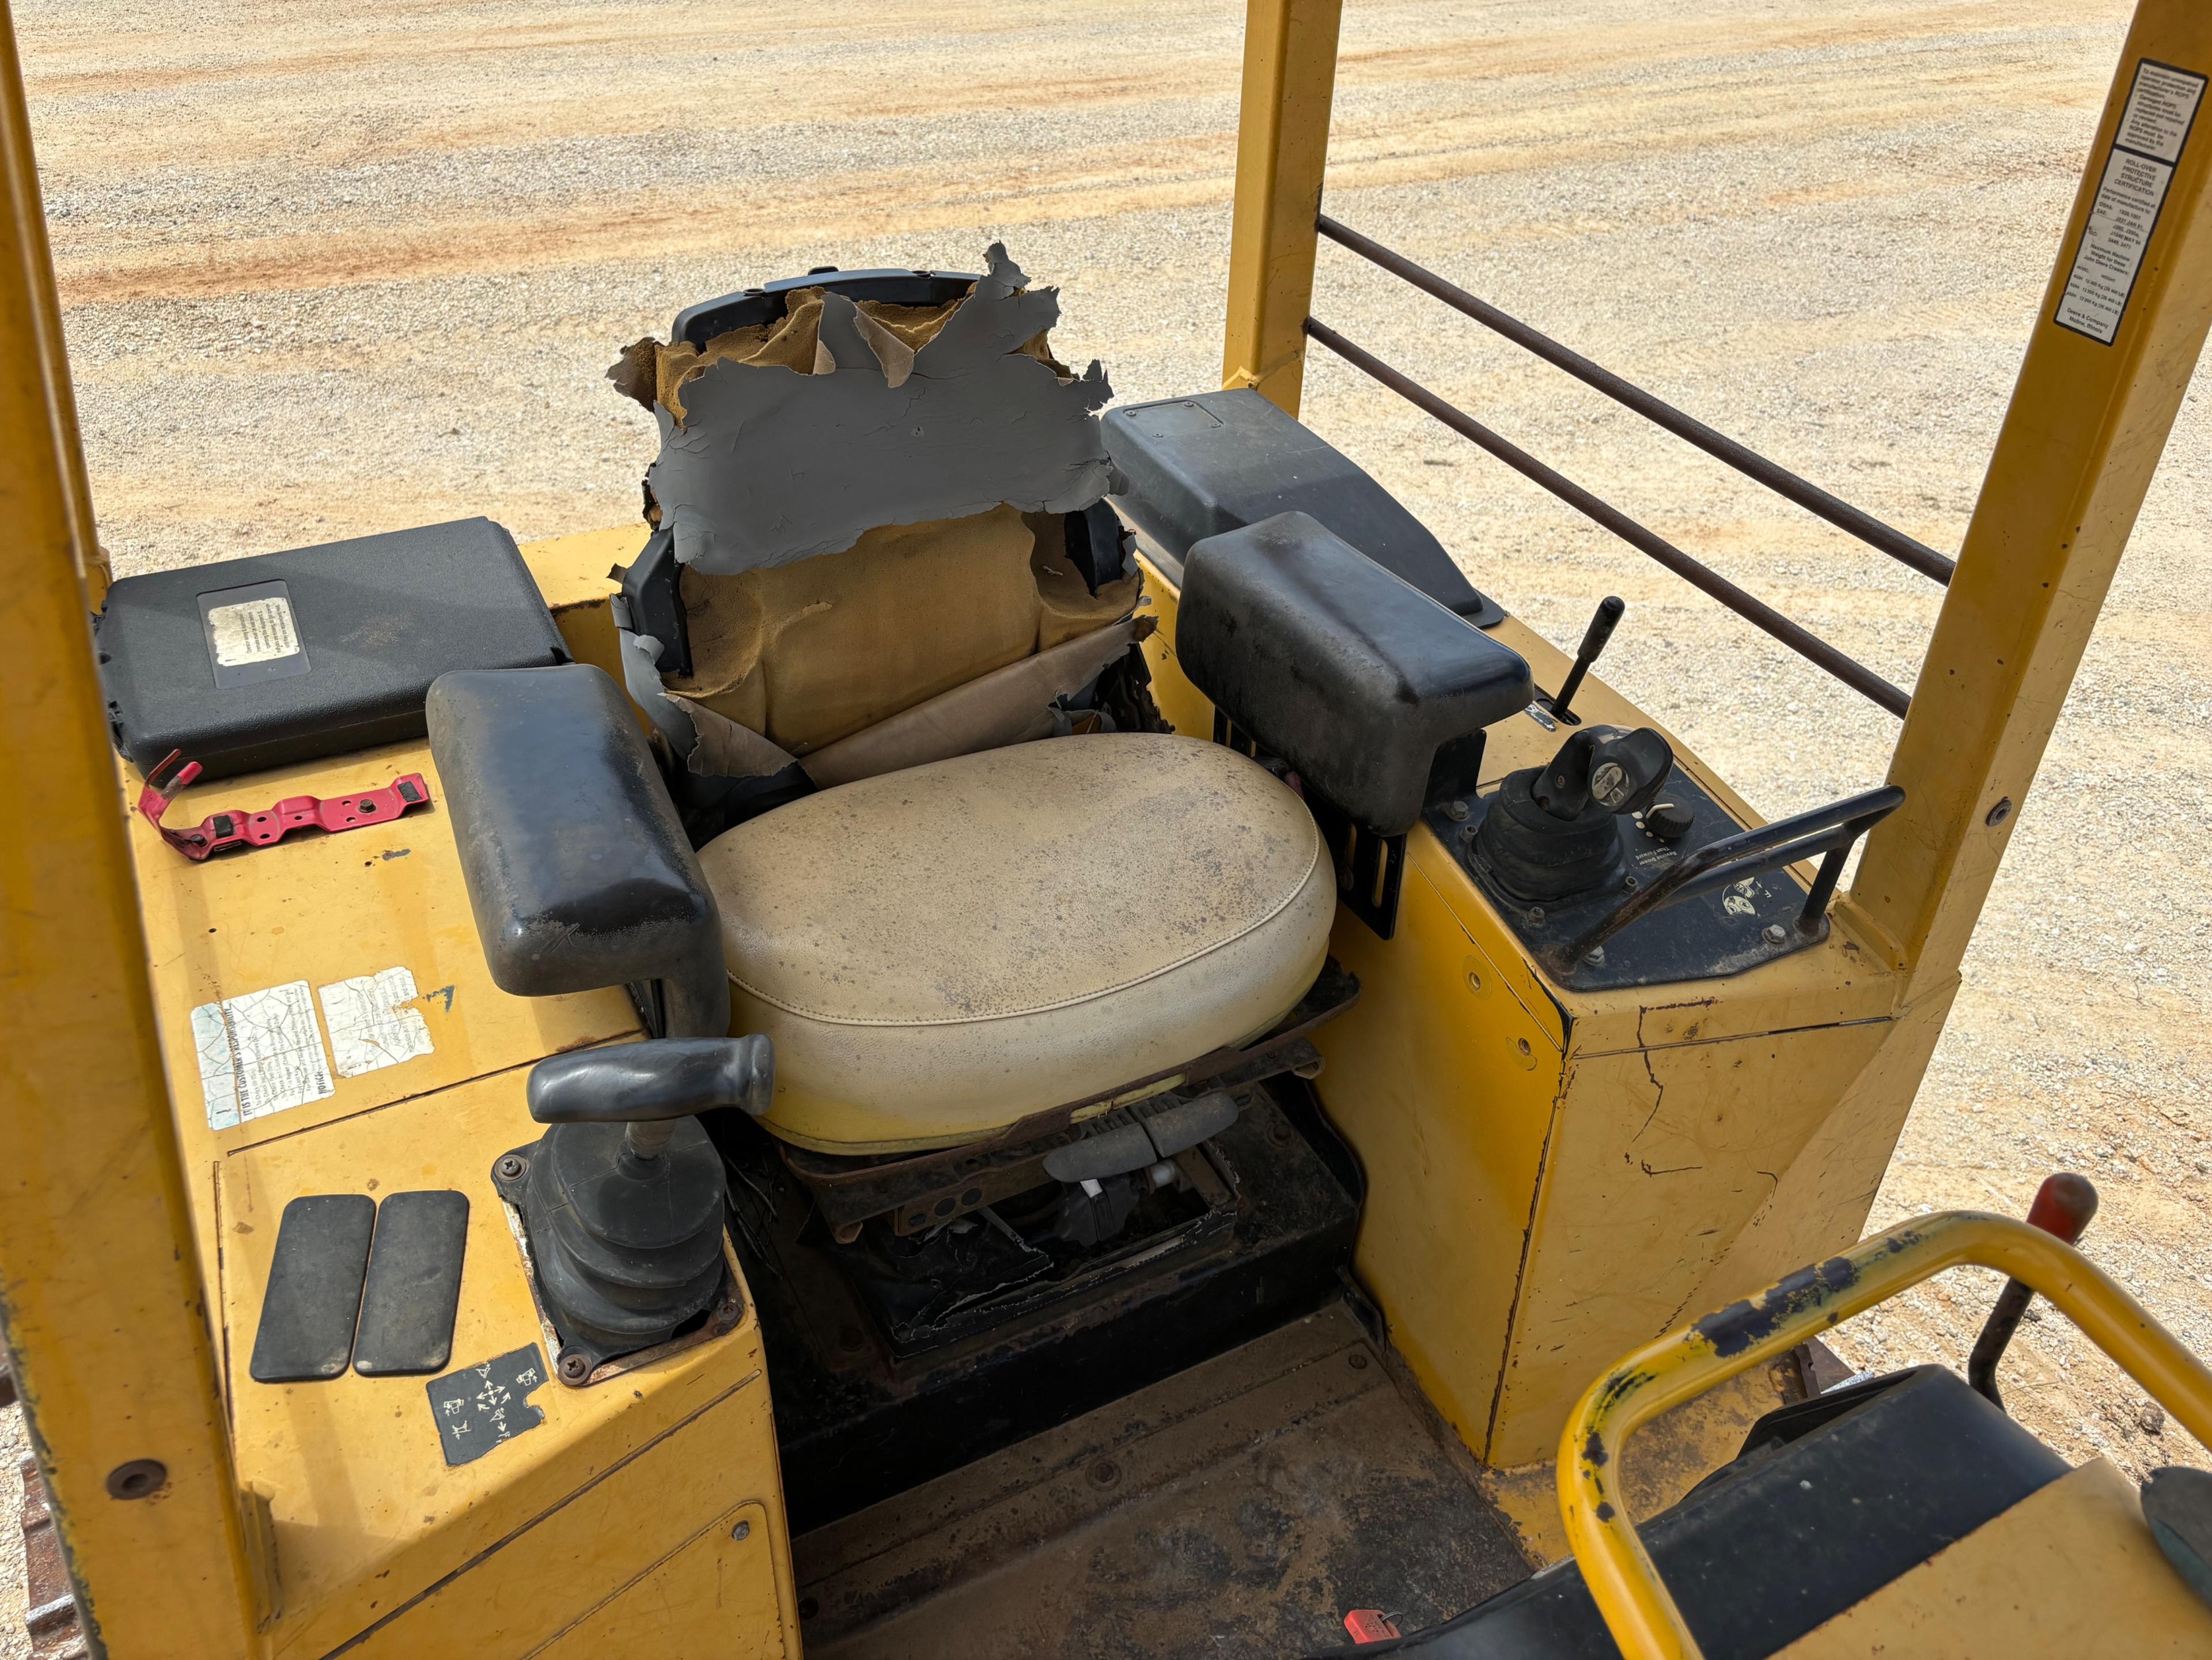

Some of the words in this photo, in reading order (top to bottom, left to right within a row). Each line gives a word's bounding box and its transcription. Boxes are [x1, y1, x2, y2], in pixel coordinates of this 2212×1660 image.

[2126, 158, 2156, 172] ROLL-OVER
[2123, 166, 2155, 180] PROTECTIVE
[2121, 173, 2152, 187] STRUCTURE
[2103, 186, 2131, 199] Performance
[2115, 179, 2154, 196] CERTIFICATION
[2117, 199, 2144, 211] manufacture
[2090, 243, 2111, 254] Maximum
[2112, 251, 2130, 261] Machine
[2091, 251, 2106, 259] Weight
[2095, 259, 2108, 267] Deere
[2067, 308, 2081, 316] Deere
[2086, 316, 2108, 328] Company
[1635, 850, 1657, 860] Forward
[1639, 857, 1657, 865] Slower
[1656, 851, 1677, 860] Reverse
[232, 1052, 247, 1088] CUSTOMER'S
[239, 1090, 249, 1102] THE
